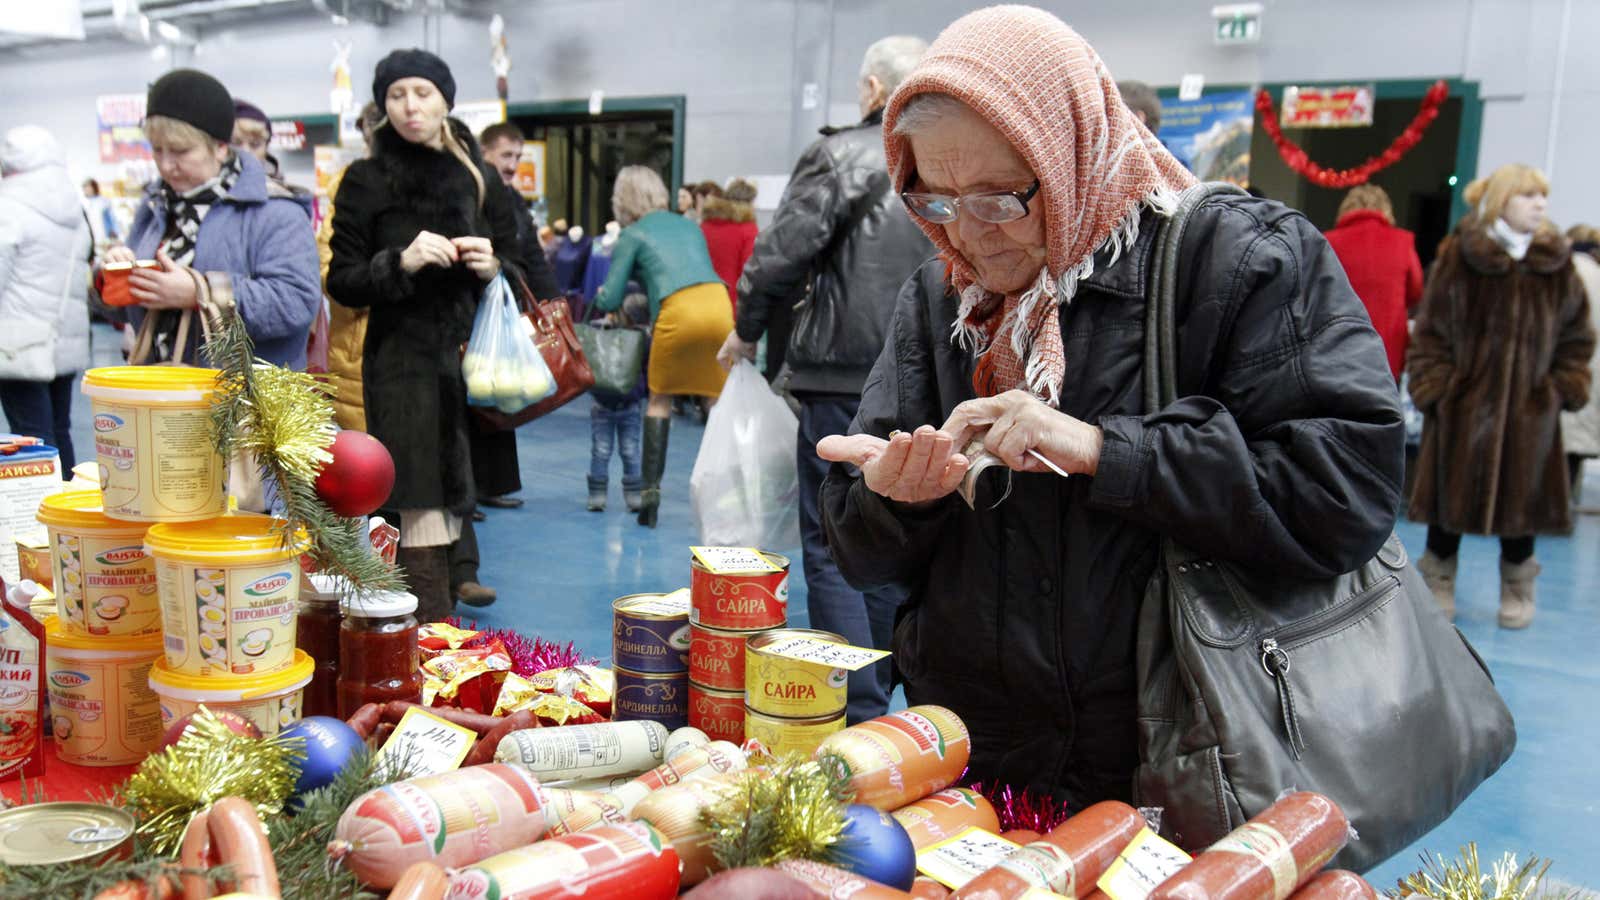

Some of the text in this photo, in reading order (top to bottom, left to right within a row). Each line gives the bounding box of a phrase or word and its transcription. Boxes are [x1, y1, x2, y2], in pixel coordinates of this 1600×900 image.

[716, 596, 767, 614] САЙРА
[615, 640, 667, 655] АРДИНЕЛЛА
[690, 653, 731, 673] САЙРА
[764, 680, 817, 699] САЙРА
[617, 700, 679, 714] САРДИНЕЛЛА
